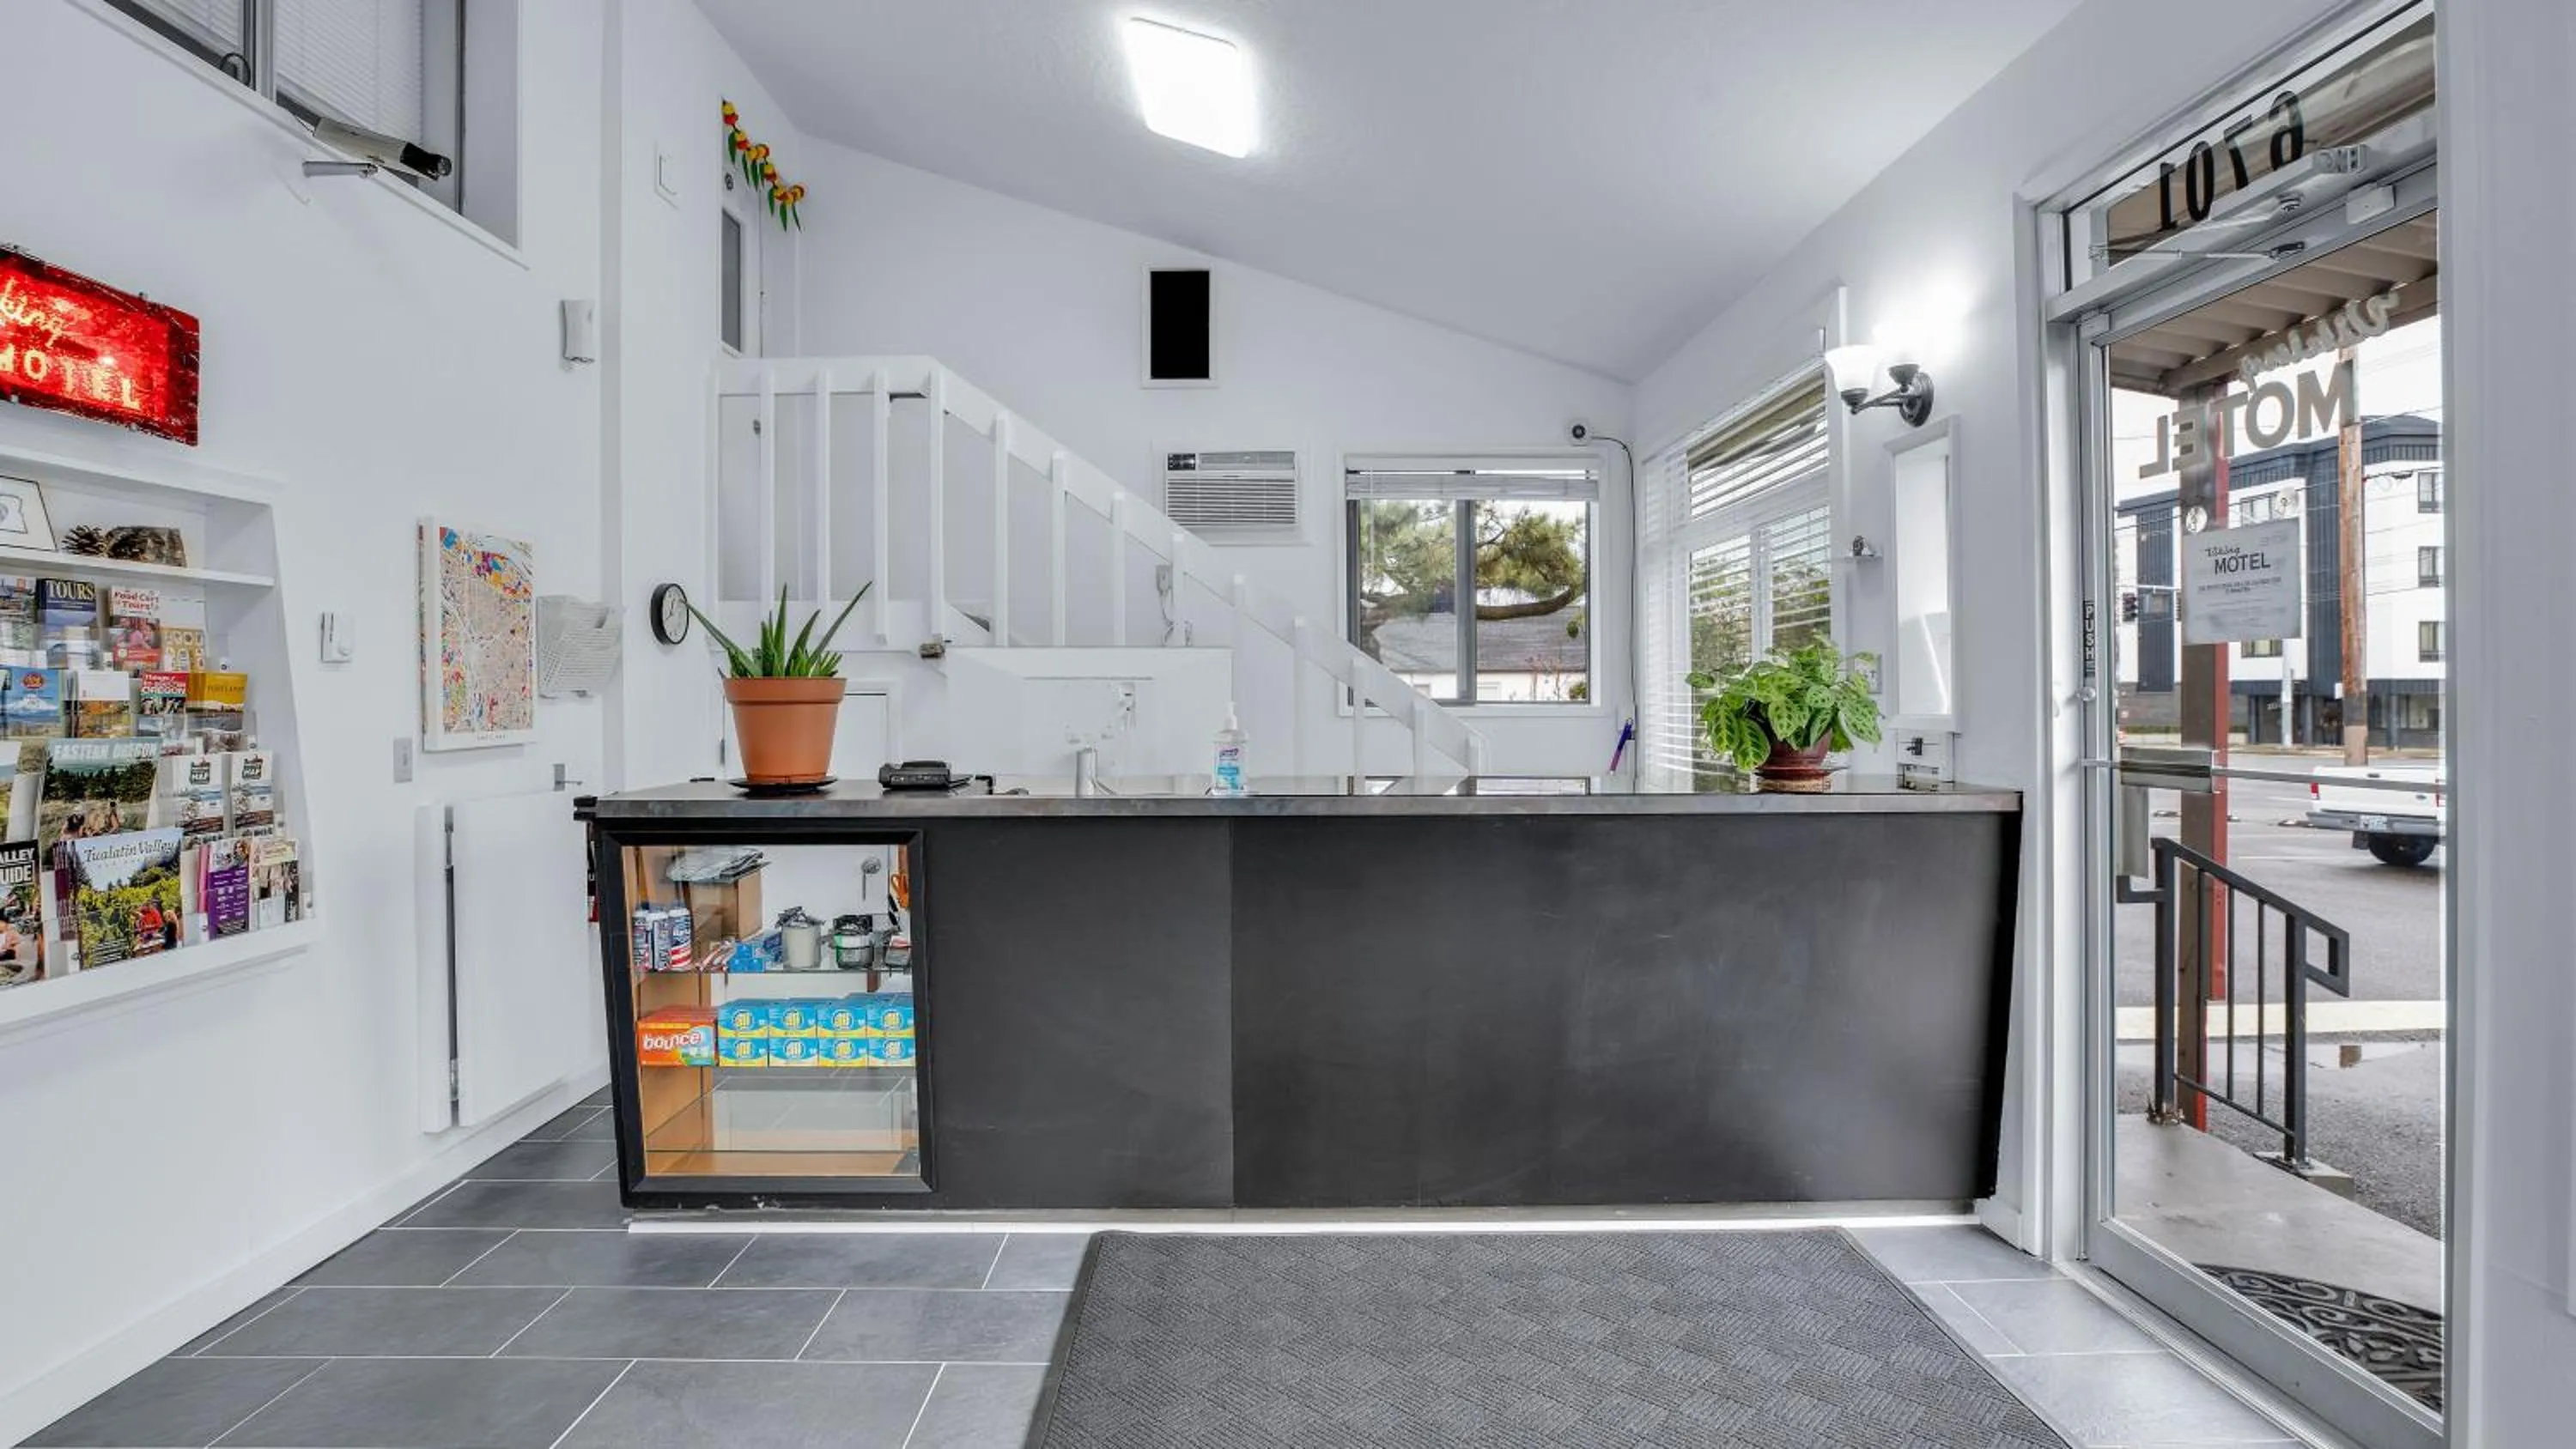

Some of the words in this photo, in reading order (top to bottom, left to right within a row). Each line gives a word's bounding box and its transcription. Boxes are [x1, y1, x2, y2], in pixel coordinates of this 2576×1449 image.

[2214, 552, 2271, 575] MOTEL
[47, 579, 94, 600] TOURS
[2085, 604, 2095, 660] PUSH
[53, 744, 111, 759] EASTERN
[0, 847, 35, 864] ALLEY
[83, 846, 137, 862] Tualatin
[138, 838, 176, 855] Valley
[0, 864, 32, 884] UIDE
[644, 1032, 702, 1051] bounce
